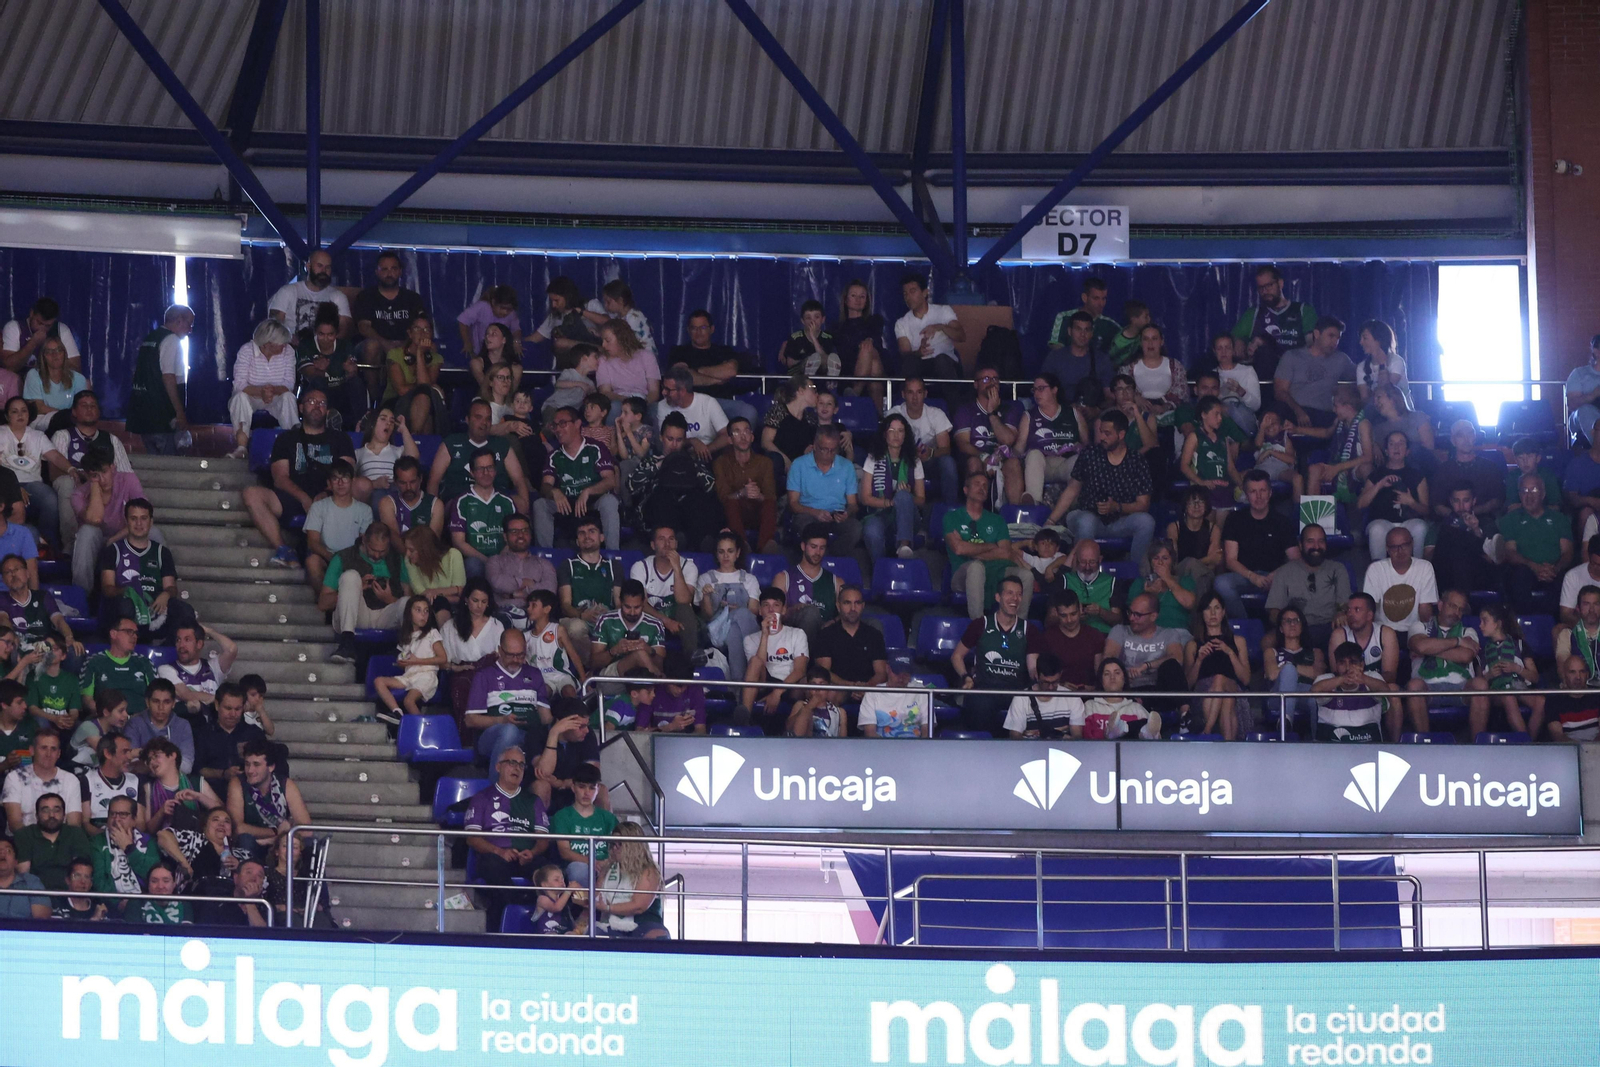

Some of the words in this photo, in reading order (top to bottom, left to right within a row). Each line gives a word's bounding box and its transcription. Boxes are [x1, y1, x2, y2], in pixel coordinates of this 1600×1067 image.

[1058, 232, 1097, 256] D7
[754, 767, 896, 811] Unicaja
[1089, 771, 1232, 814] Unicaja
[1420, 773, 1560, 817] Unicaja
[482, 990, 511, 1021] la
[520, 992, 638, 1025] ciudad
[1287, 1004, 1317, 1034] la
[1326, 1004, 1446, 1034] ciudad
[482, 1024, 625, 1056] redonda
[1288, 1036, 1433, 1065] redonda
